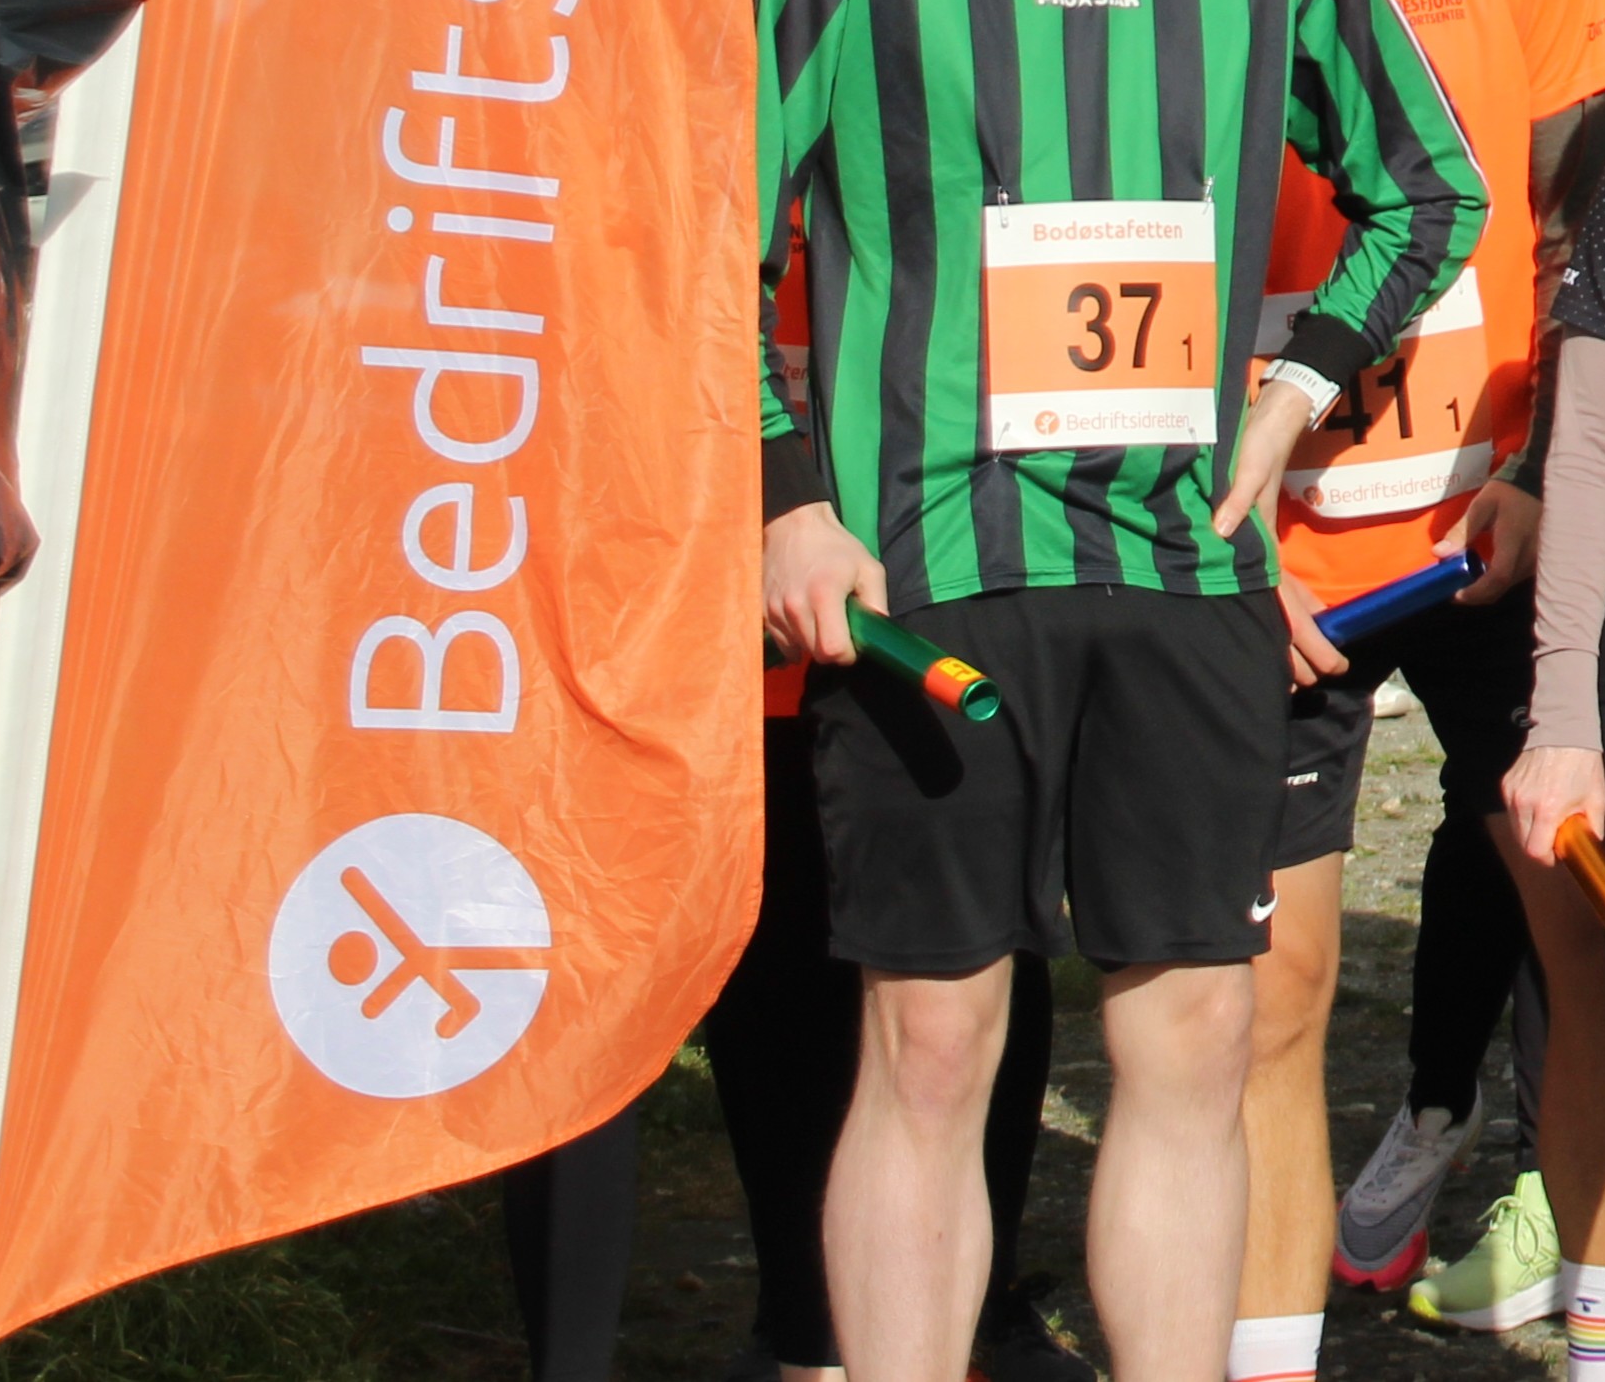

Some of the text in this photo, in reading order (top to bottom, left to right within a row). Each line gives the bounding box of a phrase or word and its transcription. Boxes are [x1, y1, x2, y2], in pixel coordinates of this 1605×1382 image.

[1032, 220, 1184, 242] Bodøstafetten
[1066, 281, 1193, 373] 37 1
[1066, 411, 1190, 432] Bedriftsidretten
[1445, 397, 1461, 433] 1
[1329, 472, 1462, 505] Bedriftsidretten
